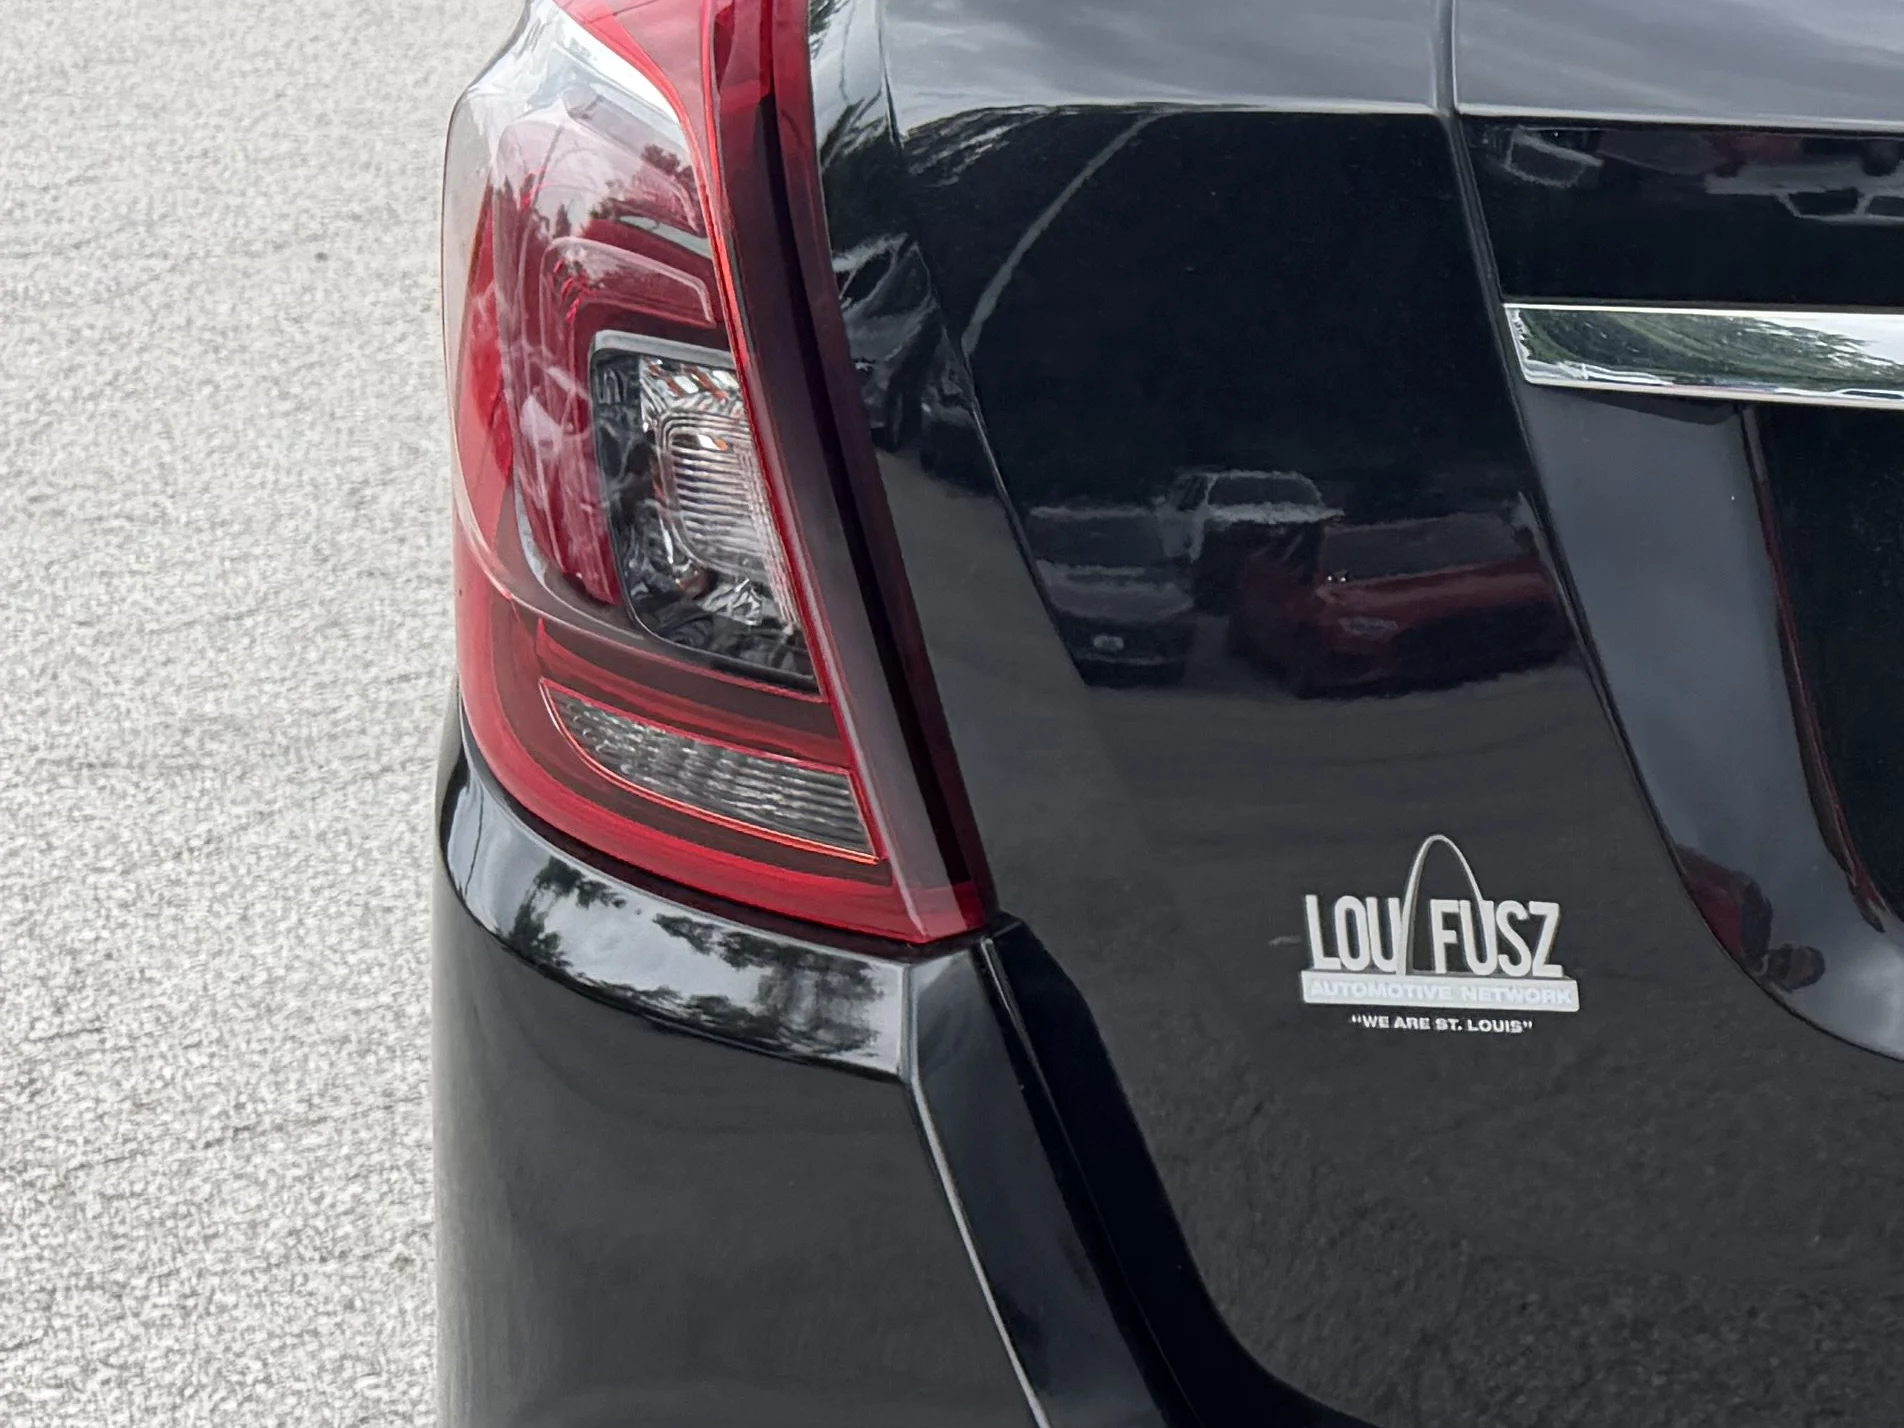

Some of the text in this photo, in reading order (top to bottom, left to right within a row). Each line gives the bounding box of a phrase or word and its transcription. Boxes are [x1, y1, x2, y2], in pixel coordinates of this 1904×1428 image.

[1304, 893, 1564, 978] LOU FUSZ
[1310, 979, 1574, 1005] AUTOMOTIVE NETWORK
[1394, 1016, 1431, 1030] ARE
[1435, 1017, 1463, 1032] ST.
